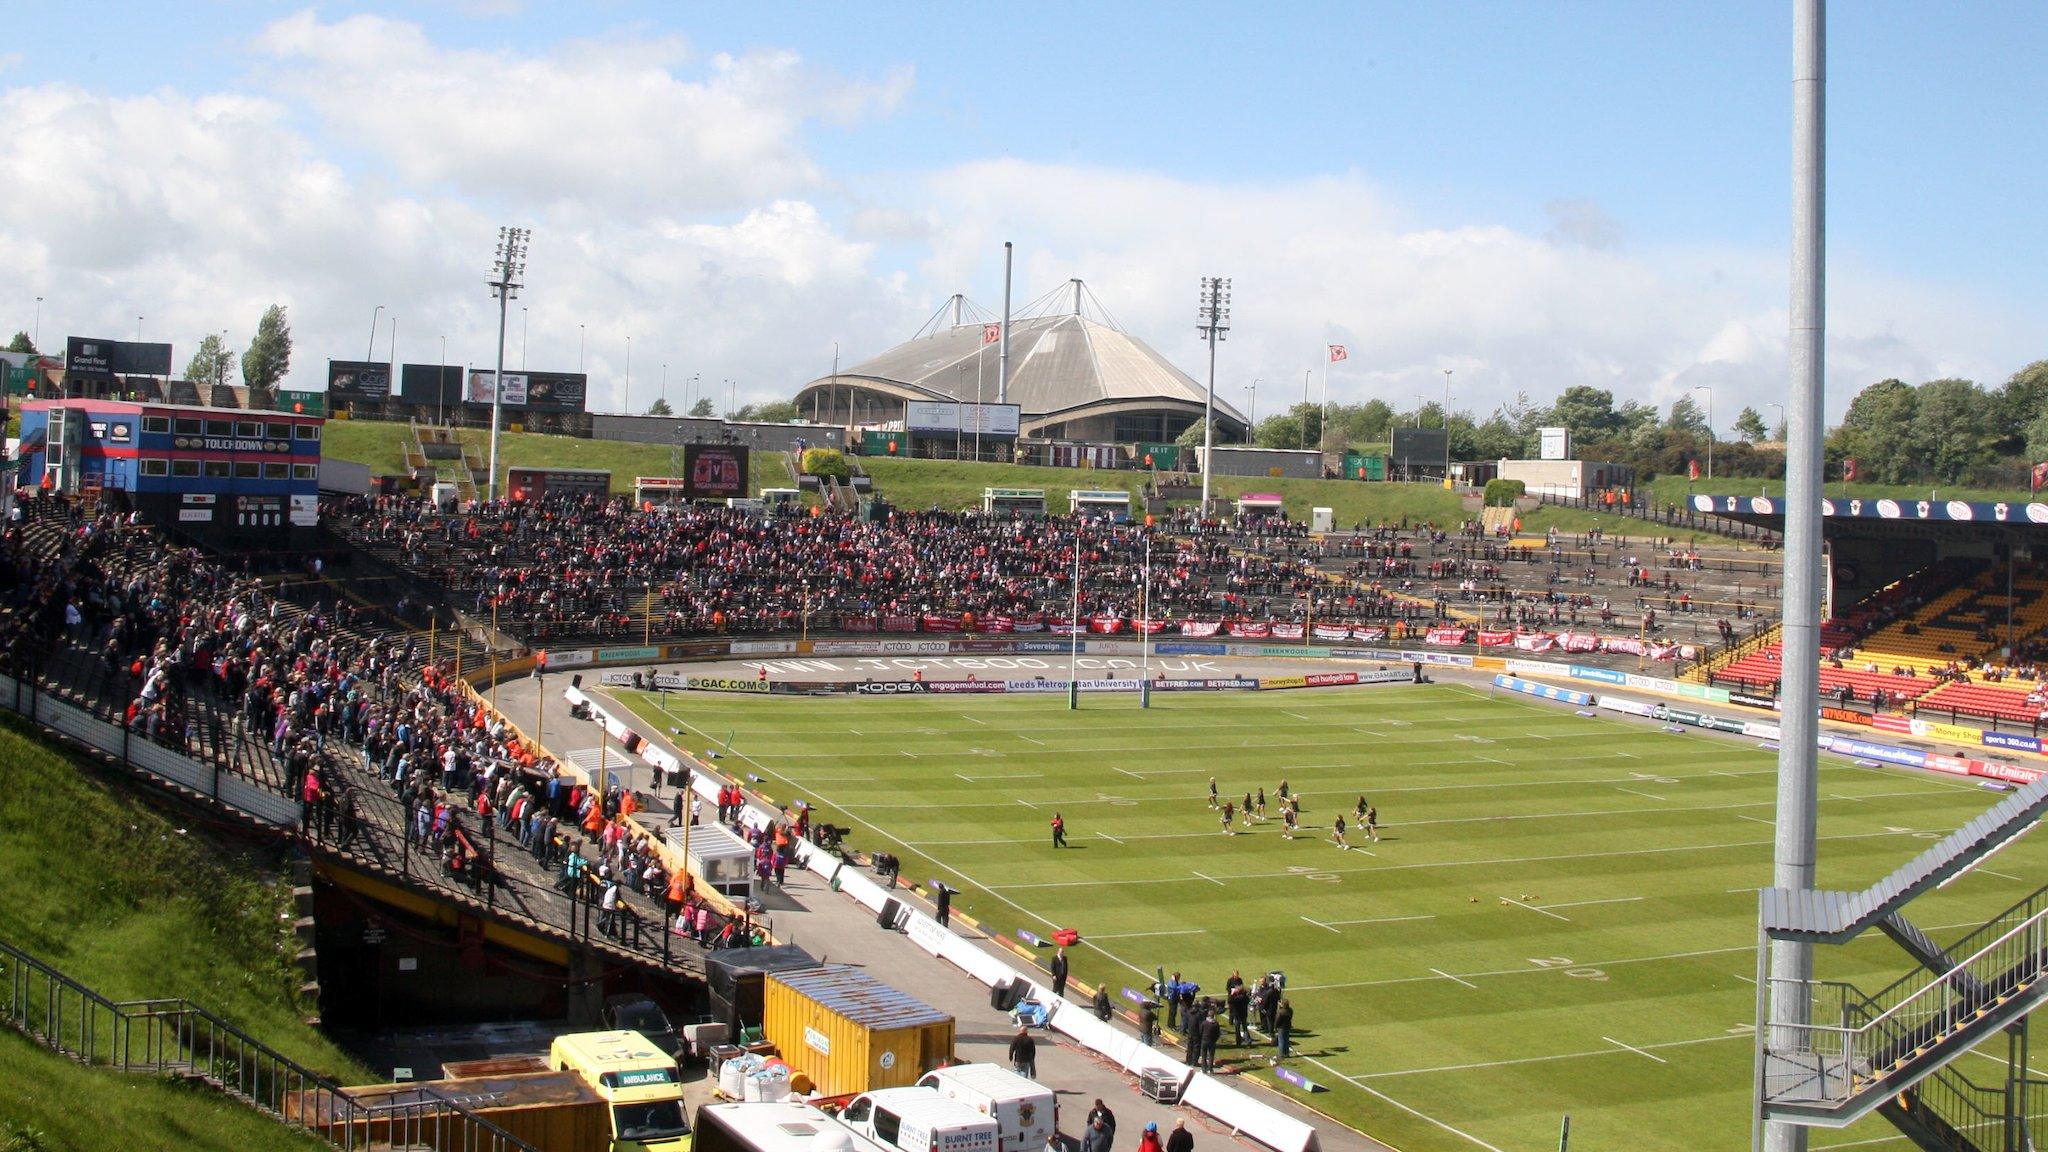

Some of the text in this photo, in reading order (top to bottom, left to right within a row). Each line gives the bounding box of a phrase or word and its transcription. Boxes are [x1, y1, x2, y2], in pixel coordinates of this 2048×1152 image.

[74, 356, 107, 366] Grand Final
[1024, 641, 1060, 652] Sovereign
[701, 678, 757, 690] GAC.COM
[856, 682, 924, 692] KOOGA
[929, 681, 1006, 691] engagemutual.com
[1009, 680, 1035, 689] Leeds
[1094, 679, 1137, 690] University
[1155, 680, 1204, 688] BETFRED.COM
[1207, 680, 1255, 688] BETFRED.COM
[1935, 727, 1982, 743] Money Shop
[1985, 735, 2006, 746] sports
[1983, 762, 1998, 775] Fly
[1998, 764, 2039, 781] Emirates
[623, 1073, 666, 1086] AMBULANCE
[944, 1134, 973, 1144] BURNT
[974, 1131, 993, 1141] TREE
